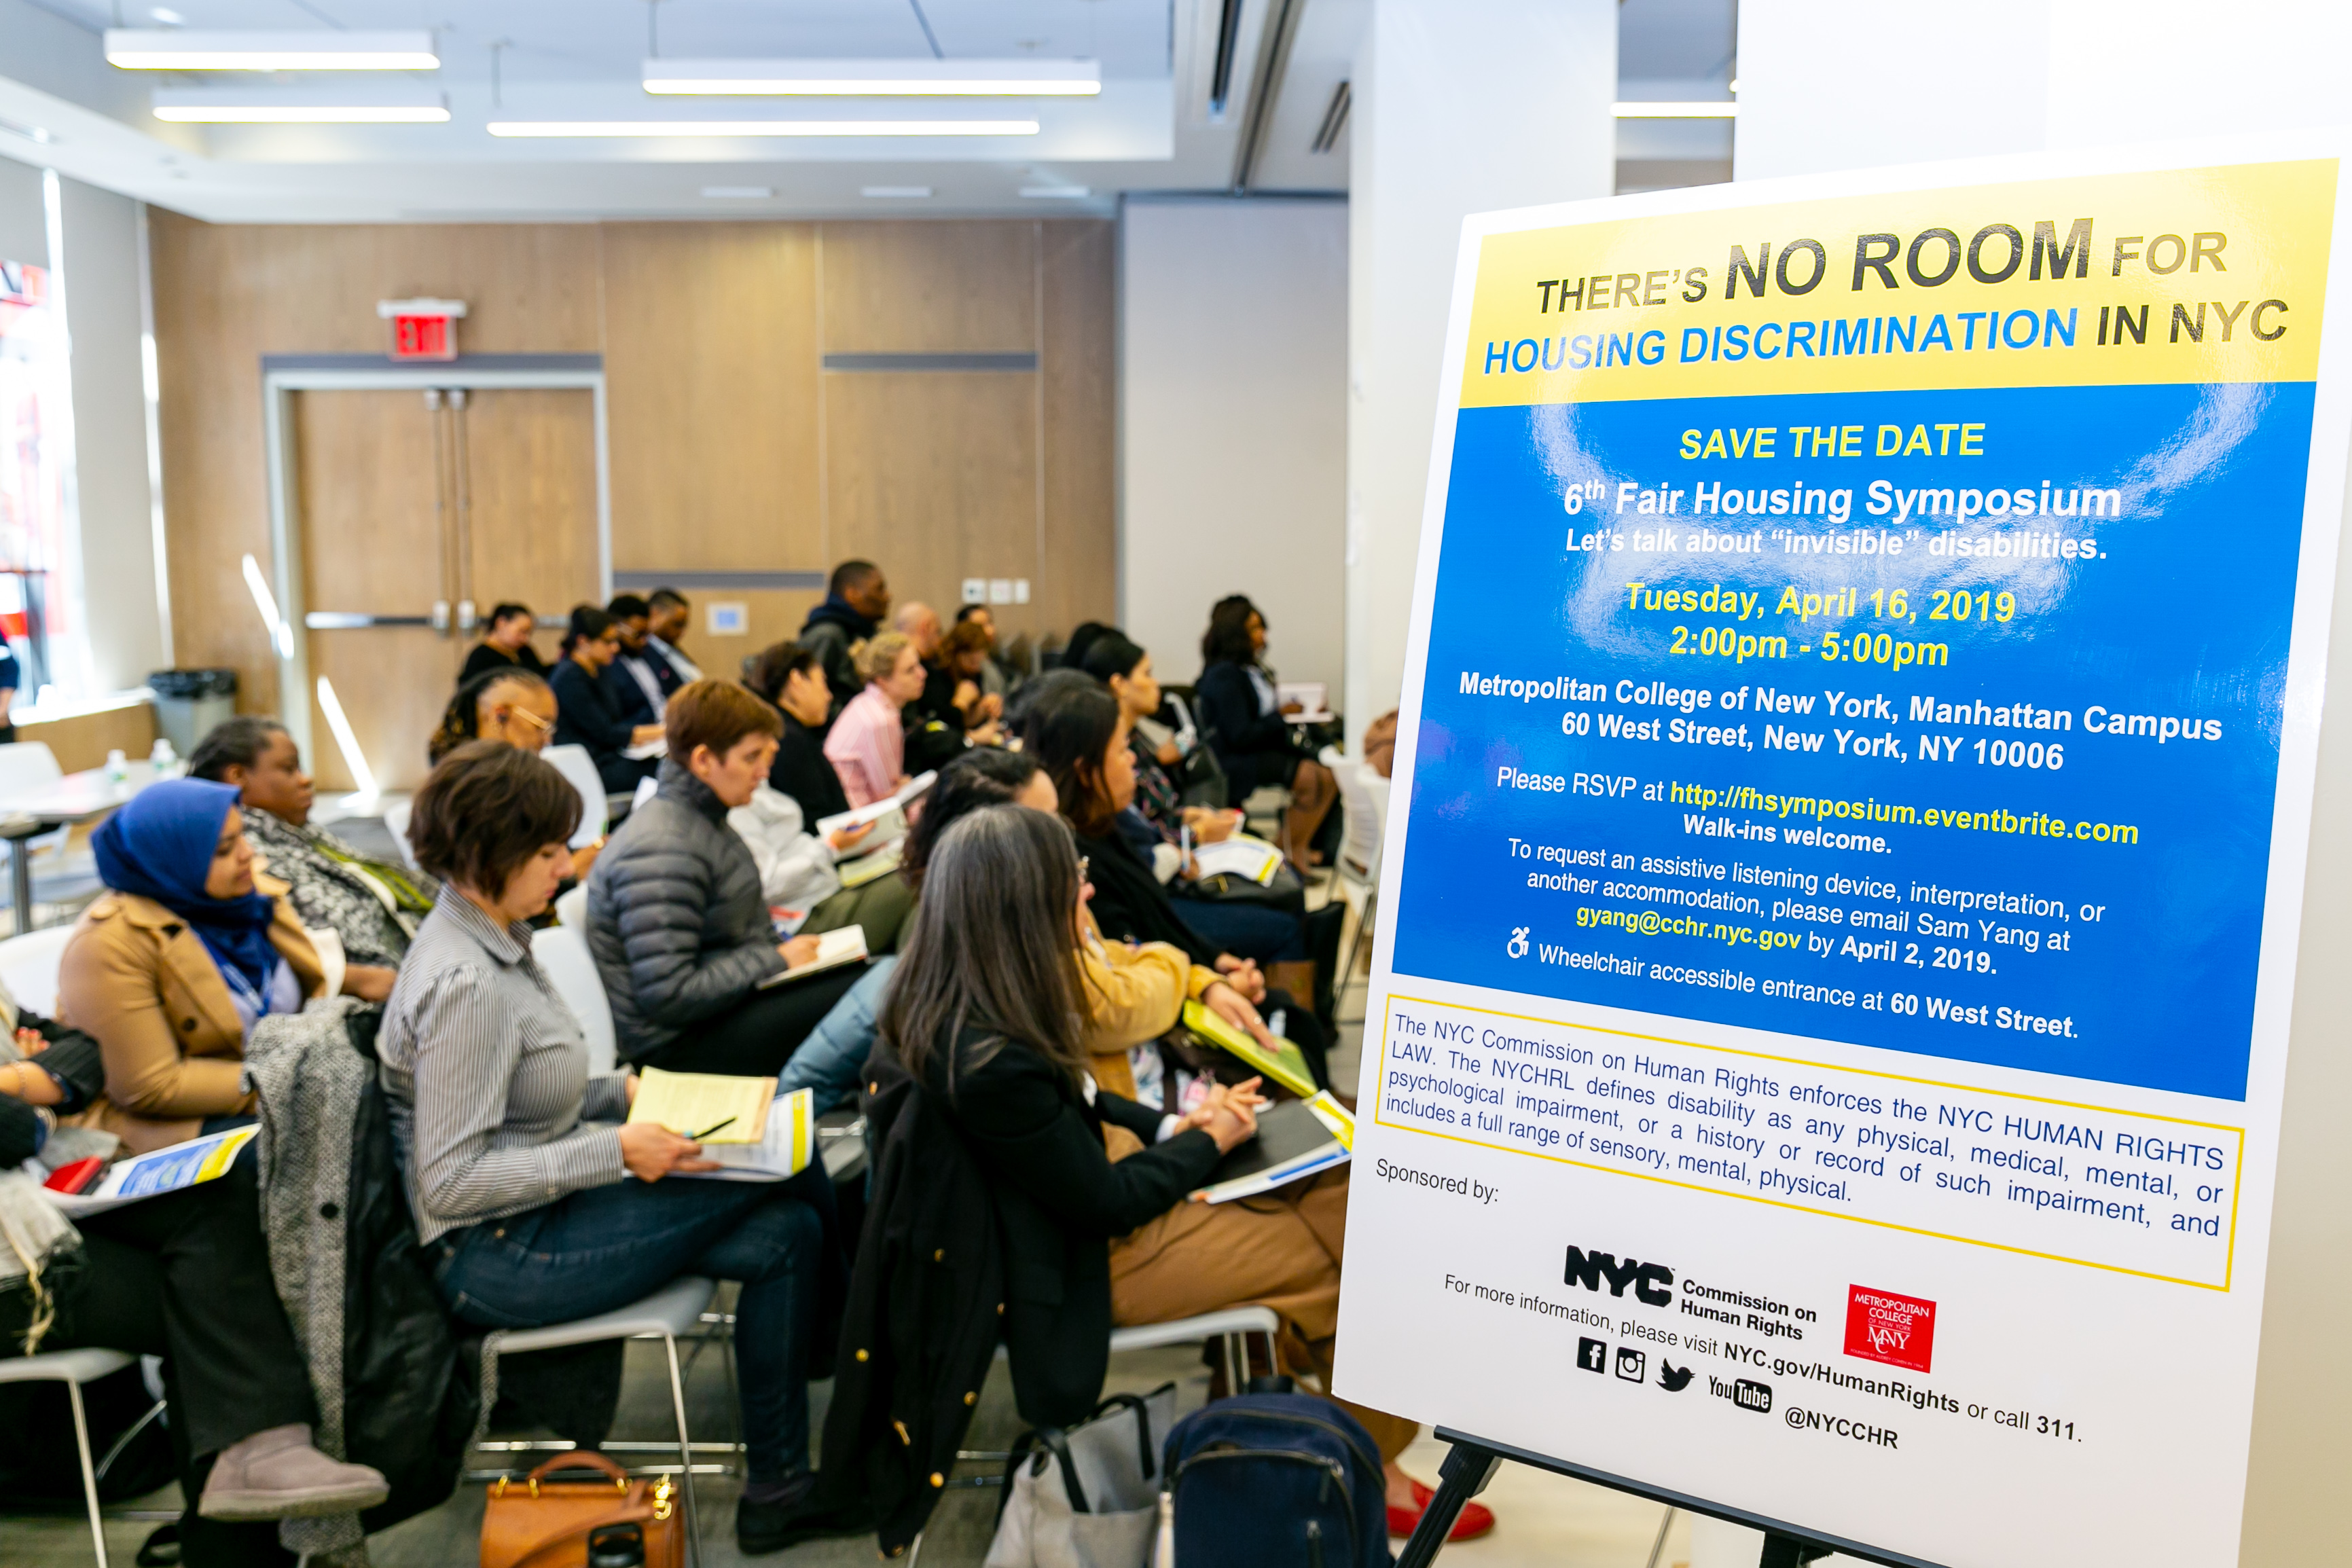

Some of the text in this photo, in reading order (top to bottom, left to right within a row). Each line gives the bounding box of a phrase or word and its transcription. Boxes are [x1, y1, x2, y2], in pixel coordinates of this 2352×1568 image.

[1536, 217, 2228, 314] THERE’S NO ROOM FOR
[1484, 299, 2289, 374] HOUSING DISCRIMINATION IN NYC
[1678, 422, 1986, 460] SAVE THE DATE
[1615, 481, 1685, 515] Fair
[1693, 481, 1853, 524] Housing
[1865, 479, 2121, 525] Symposium
[1566, 528, 2107, 560] Let’s talk about “invisible” disabilities.
[1625, 583, 2014, 624] Tuesday, April 16, 2019
[1669, 626, 1786, 664] 2:00pm
[1821, 632, 1948, 672] 5:00pm
[1459, 671, 2222, 744] Metropolitan College of New York, Manhattan Campus
[1561, 711, 2064, 770] 60 West Street, New York, NY 10006
[1497, 766, 2139, 844] Please RSVP at http://fhsymposium.eventbrite.com
[1683, 814, 1892, 854] Walk-ins welcome.
[1508, 837, 2106, 922] To request an assistive listening device, interpretation, or
[1527, 872, 2071, 953] another accommodation, please email Sam Yang at
[1576, 907, 1997, 974] gyang@cchr.nyc.gov by April 2, 2019.
[1539, 943, 2078, 1038] Wheelchair accessible entrance at 60 West Street.
[1395, 1014, 2224, 1170] The NYC Commission on Human Rights enforces the NYC HUMAN RIGHTS
[1392, 1040, 2224, 1203] LAW. The NYCHRL defines disability as any physical, medical, mental, or
[1387, 1097, 1851, 1202] includes a full range of sensory, mental, physical.
[1388, 1071, 2220, 1237] psychological impairment, or a history or record of such impairment, and
[1376, 1158, 1498, 1205] Sponsored by:
[1563, 1244, 1675, 1308] NYC
[1682, 1279, 1817, 1323] Commission on
[1680, 1298, 1803, 1341] Human Rights
[1854, 1293, 1930, 1317] METROPOLITAN
[1868, 1307, 1913, 1325] COLLEGE
[1878, 1320, 1894, 1328] NEW
[1445, 1273, 2082, 1442] For more information, please visit NYC.gov/HumanRights or call 311.
[1850, 1348, 1870, 1357] FOUNDED
[1708, 1374, 1770, 1410] YouTube
[1785, 1406, 1898, 1450] @NYCCHR
